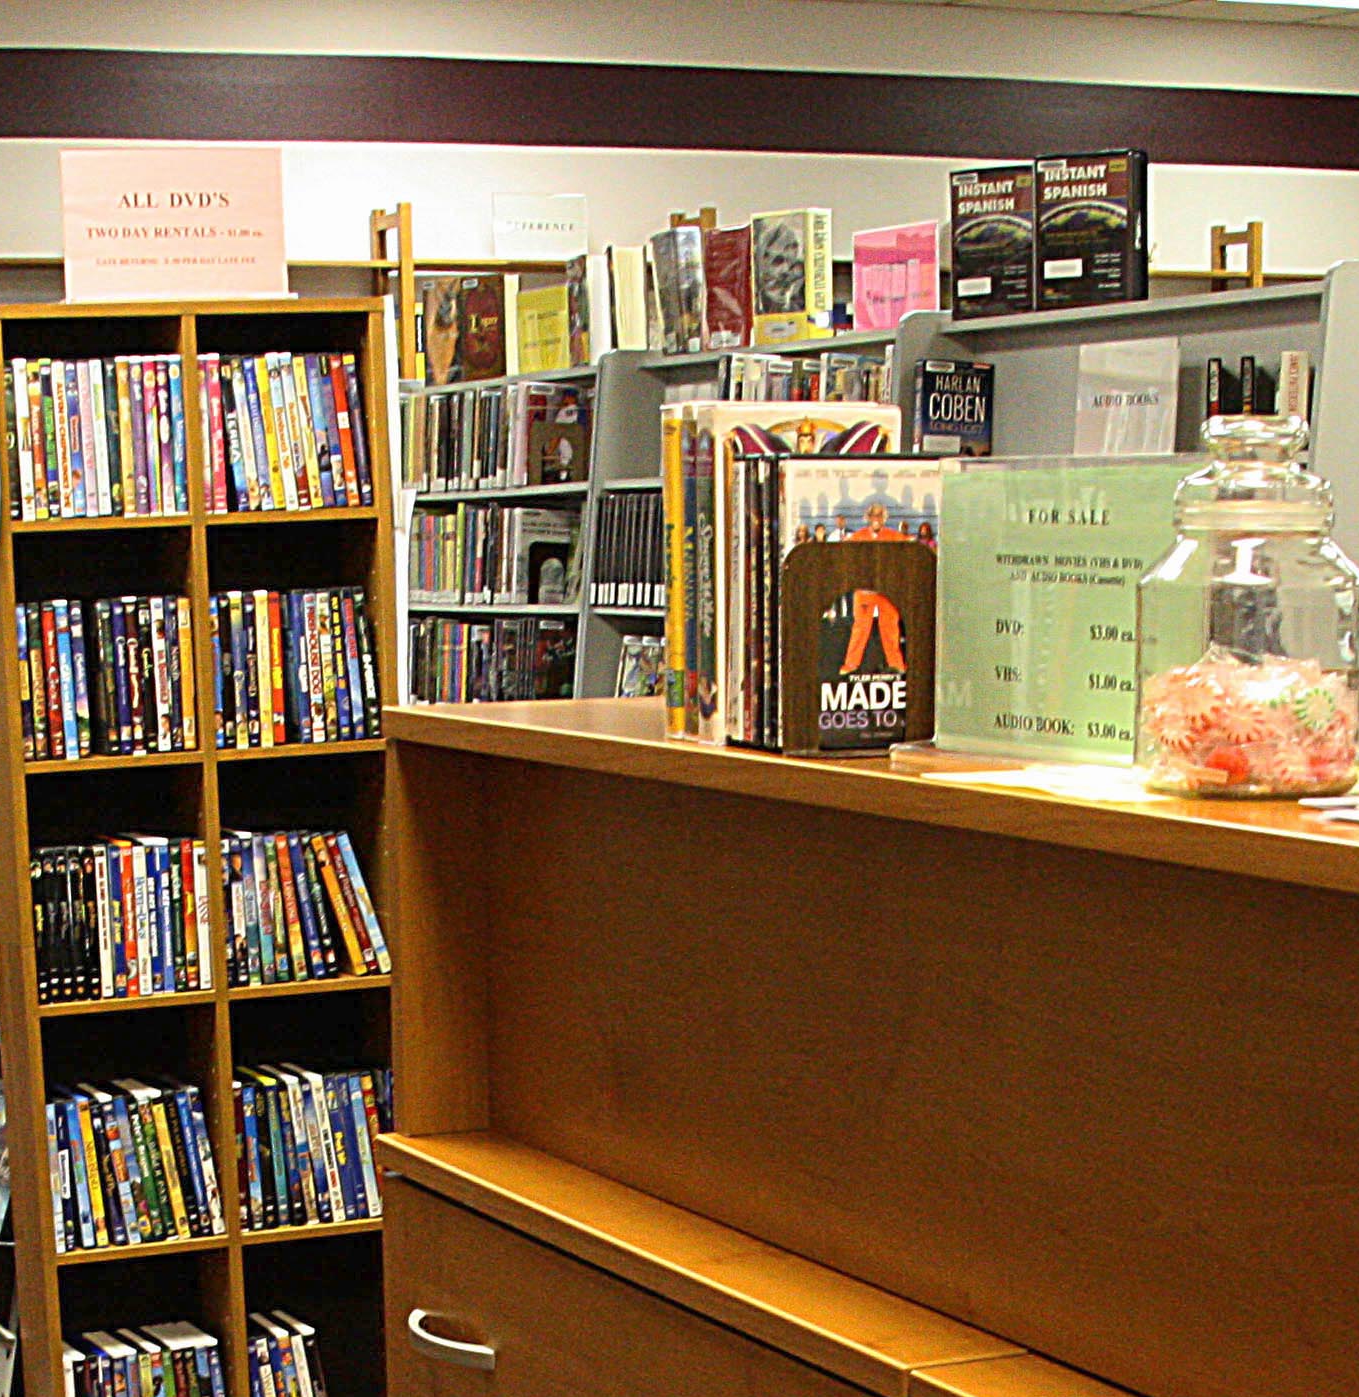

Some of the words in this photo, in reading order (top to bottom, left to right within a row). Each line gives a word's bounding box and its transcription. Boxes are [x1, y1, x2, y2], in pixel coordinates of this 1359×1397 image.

[1043, 164, 1107, 183] INSTANT
[957, 180, 1014, 198] INSTANT
[1043, 183, 1108, 200] SPANISH
[118, 192, 159, 209] ALL
[169, 191, 231, 209] DVD'S
[957, 198, 1015, 215] SPANISH
[87, 226, 119, 239] TWO
[122, 226, 149, 238] DAY
[153, 226, 217, 238] RENTALS
[935, 374, 981, 394] HARLAN
[929, 392, 987, 423] COBEN
[1093, 394, 1123, 408] AUDIO
[1126, 392, 1160, 407] BOOKS
[1028, 509, 1060, 524] FOR
[1068, 508, 1111, 526] SALE
[1054, 555, 1087, 567] MOVIES
[1031, 571, 1057, 582] AUDIO
[995, 618, 1024, 636] DVD:
[1090, 625, 1119, 641] $3.00
[1121, 631, 1136, 642] ea.
[995, 665, 1022, 682] VHS:
[1089, 674, 1117, 690] $1.00
[1119, 679, 1136, 692] ea.
[819, 711, 869, 730] GOES
[872, 710, 898, 728] TO
[994, 712, 1033, 730] AUDIO
[1036, 716, 1075, 736] BOOK:
[1088, 723, 1116, 739] $3.00
[1119, 729, 1135, 741] ea.
